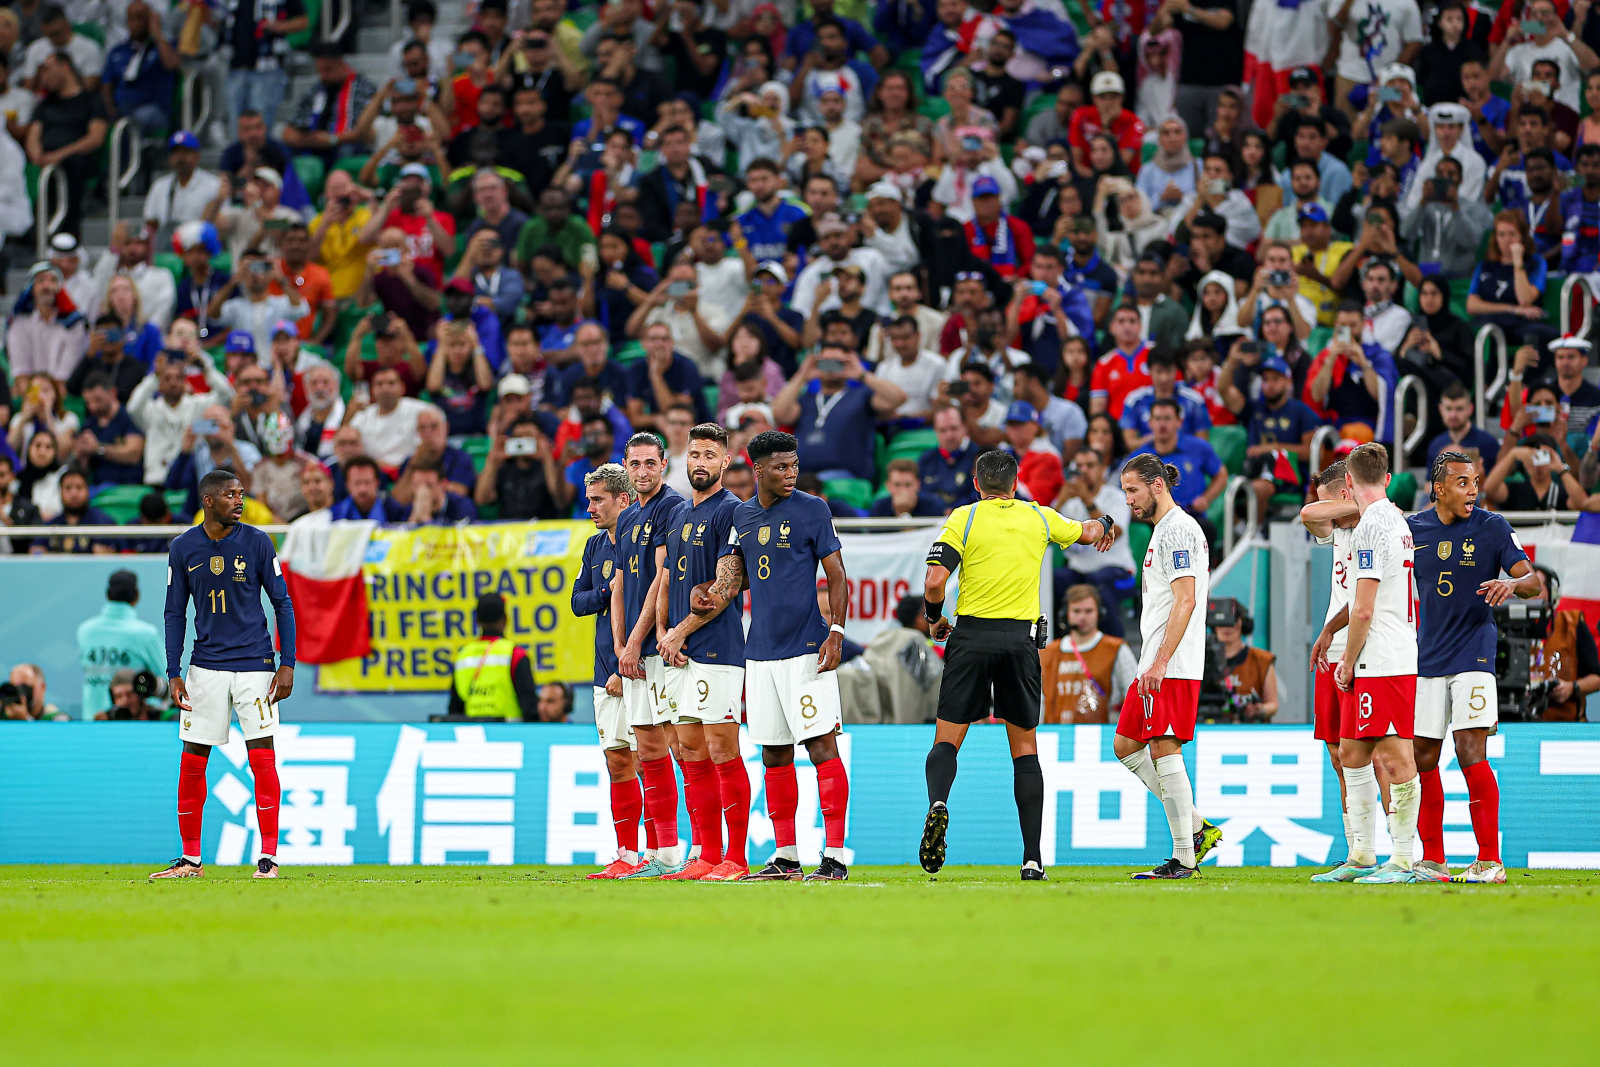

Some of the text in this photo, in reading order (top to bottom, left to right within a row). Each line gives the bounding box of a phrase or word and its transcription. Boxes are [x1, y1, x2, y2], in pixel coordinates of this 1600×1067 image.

[629, 554, 640, 579] 14
[677, 555, 689, 582] 9
[757, 554, 771, 580] 8
[1436, 571, 1454, 597] 5
[208, 589, 227, 615] 11
[399, 603, 558, 640] FERILO
[361, 642, 556, 677] PRESE
[696, 679, 711, 703] 9
[1469, 685, 1488, 711] 5
[254, 695, 274, 722] 11
[800, 694, 818, 720] 8
[1358, 692, 1374, 719] 13
